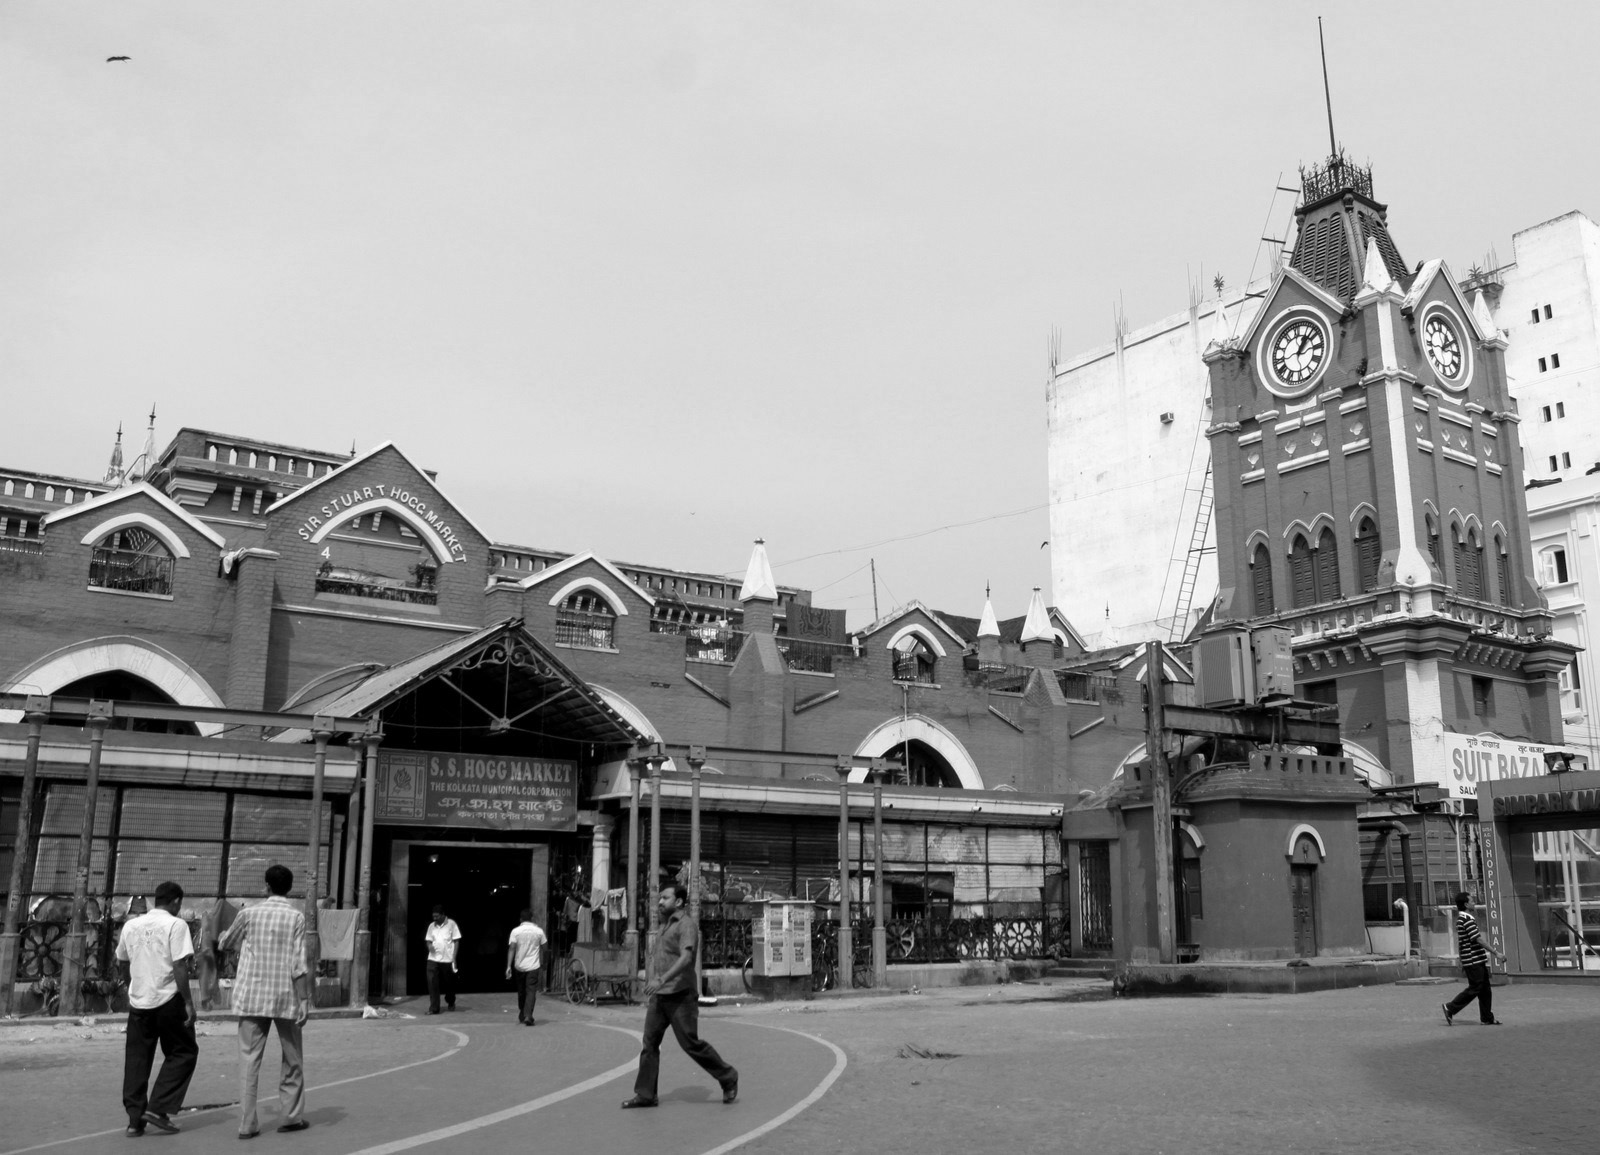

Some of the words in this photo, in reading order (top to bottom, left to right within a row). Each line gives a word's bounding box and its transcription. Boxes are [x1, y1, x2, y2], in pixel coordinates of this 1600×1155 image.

[298, 515, 322, 541] SIR
[321, 484, 386, 518] STUART
[390, 486, 426, 515] HOGG
[424, 510, 467, 563] MARKET
[320, 546, 331, 560] 4
[430, 756, 444, 777] S.
[447, 758, 460, 778] S.
[464, 758, 507, 780] HOGG
[510, 760, 572, 783] MARKET
[1452, 747, 1492, 783] SUIT
[430, 781, 445, 792] THE
[446, 782, 480, 794] KOLKATA
[482, 784, 521, 796] MUNICIPAL
[521, 786, 571, 798] CORPORATION
[1493, 791, 1574, 816] SIMPARK
[1485, 838, 1499, 920] SHOPPING
